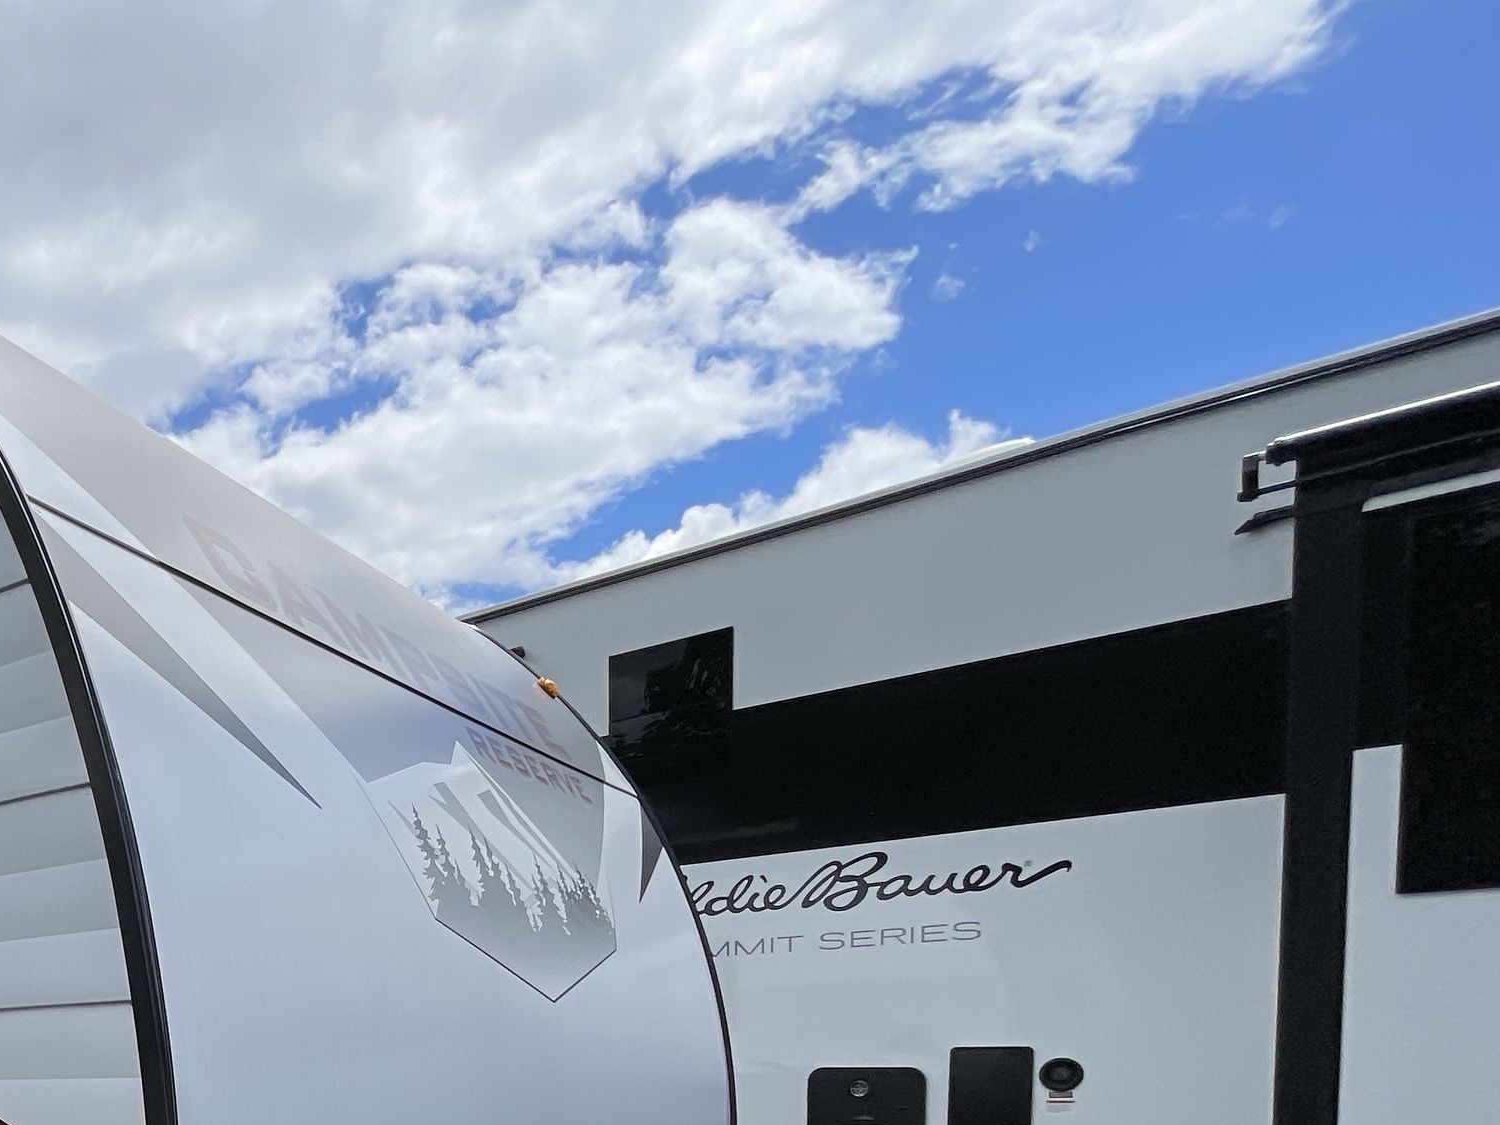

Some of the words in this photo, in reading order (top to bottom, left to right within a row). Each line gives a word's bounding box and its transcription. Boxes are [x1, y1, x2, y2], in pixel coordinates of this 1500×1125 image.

[182, 512, 572, 760] CAMPSITE
[462, 726, 594, 806] RESERVE
[800, 851, 1072, 911] Bauer
[711, 934, 805, 958] MMIT
[818, 921, 983, 951] SERIES
